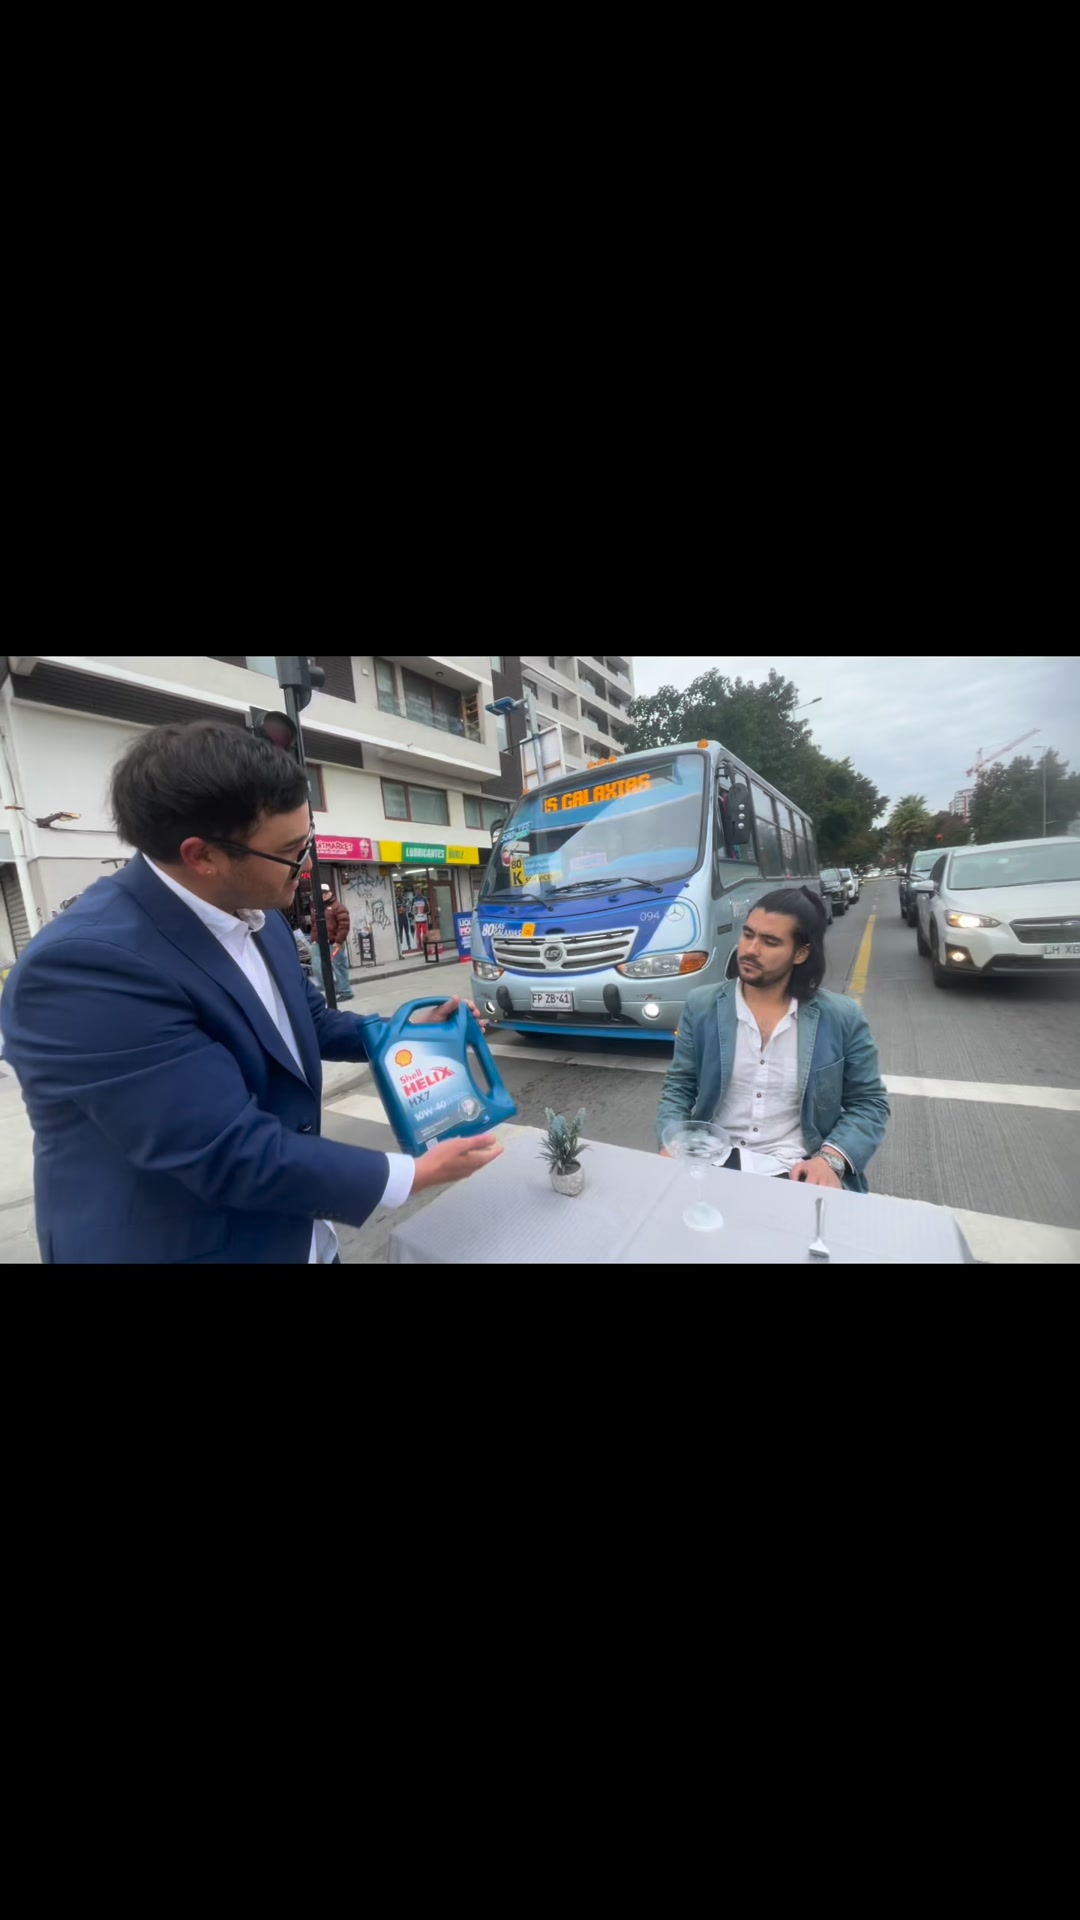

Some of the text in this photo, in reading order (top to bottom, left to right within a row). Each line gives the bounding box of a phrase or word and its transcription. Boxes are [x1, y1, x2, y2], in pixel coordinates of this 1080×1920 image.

[406, 847, 445, 858] LUBRICANTES
[511, 859, 522, 869] 80
[513, 871, 523, 885] K
[640, 911, 660, 921] 094
[482, 923, 494, 936] 80
[1044, 945, 1060, 955] LH
[532, 993, 543, 1004] FP
[399, 1068, 423, 1085] Shell
[402, 1066, 455, 1098] HELIX
[408, 1091, 431, 1108] HX7
